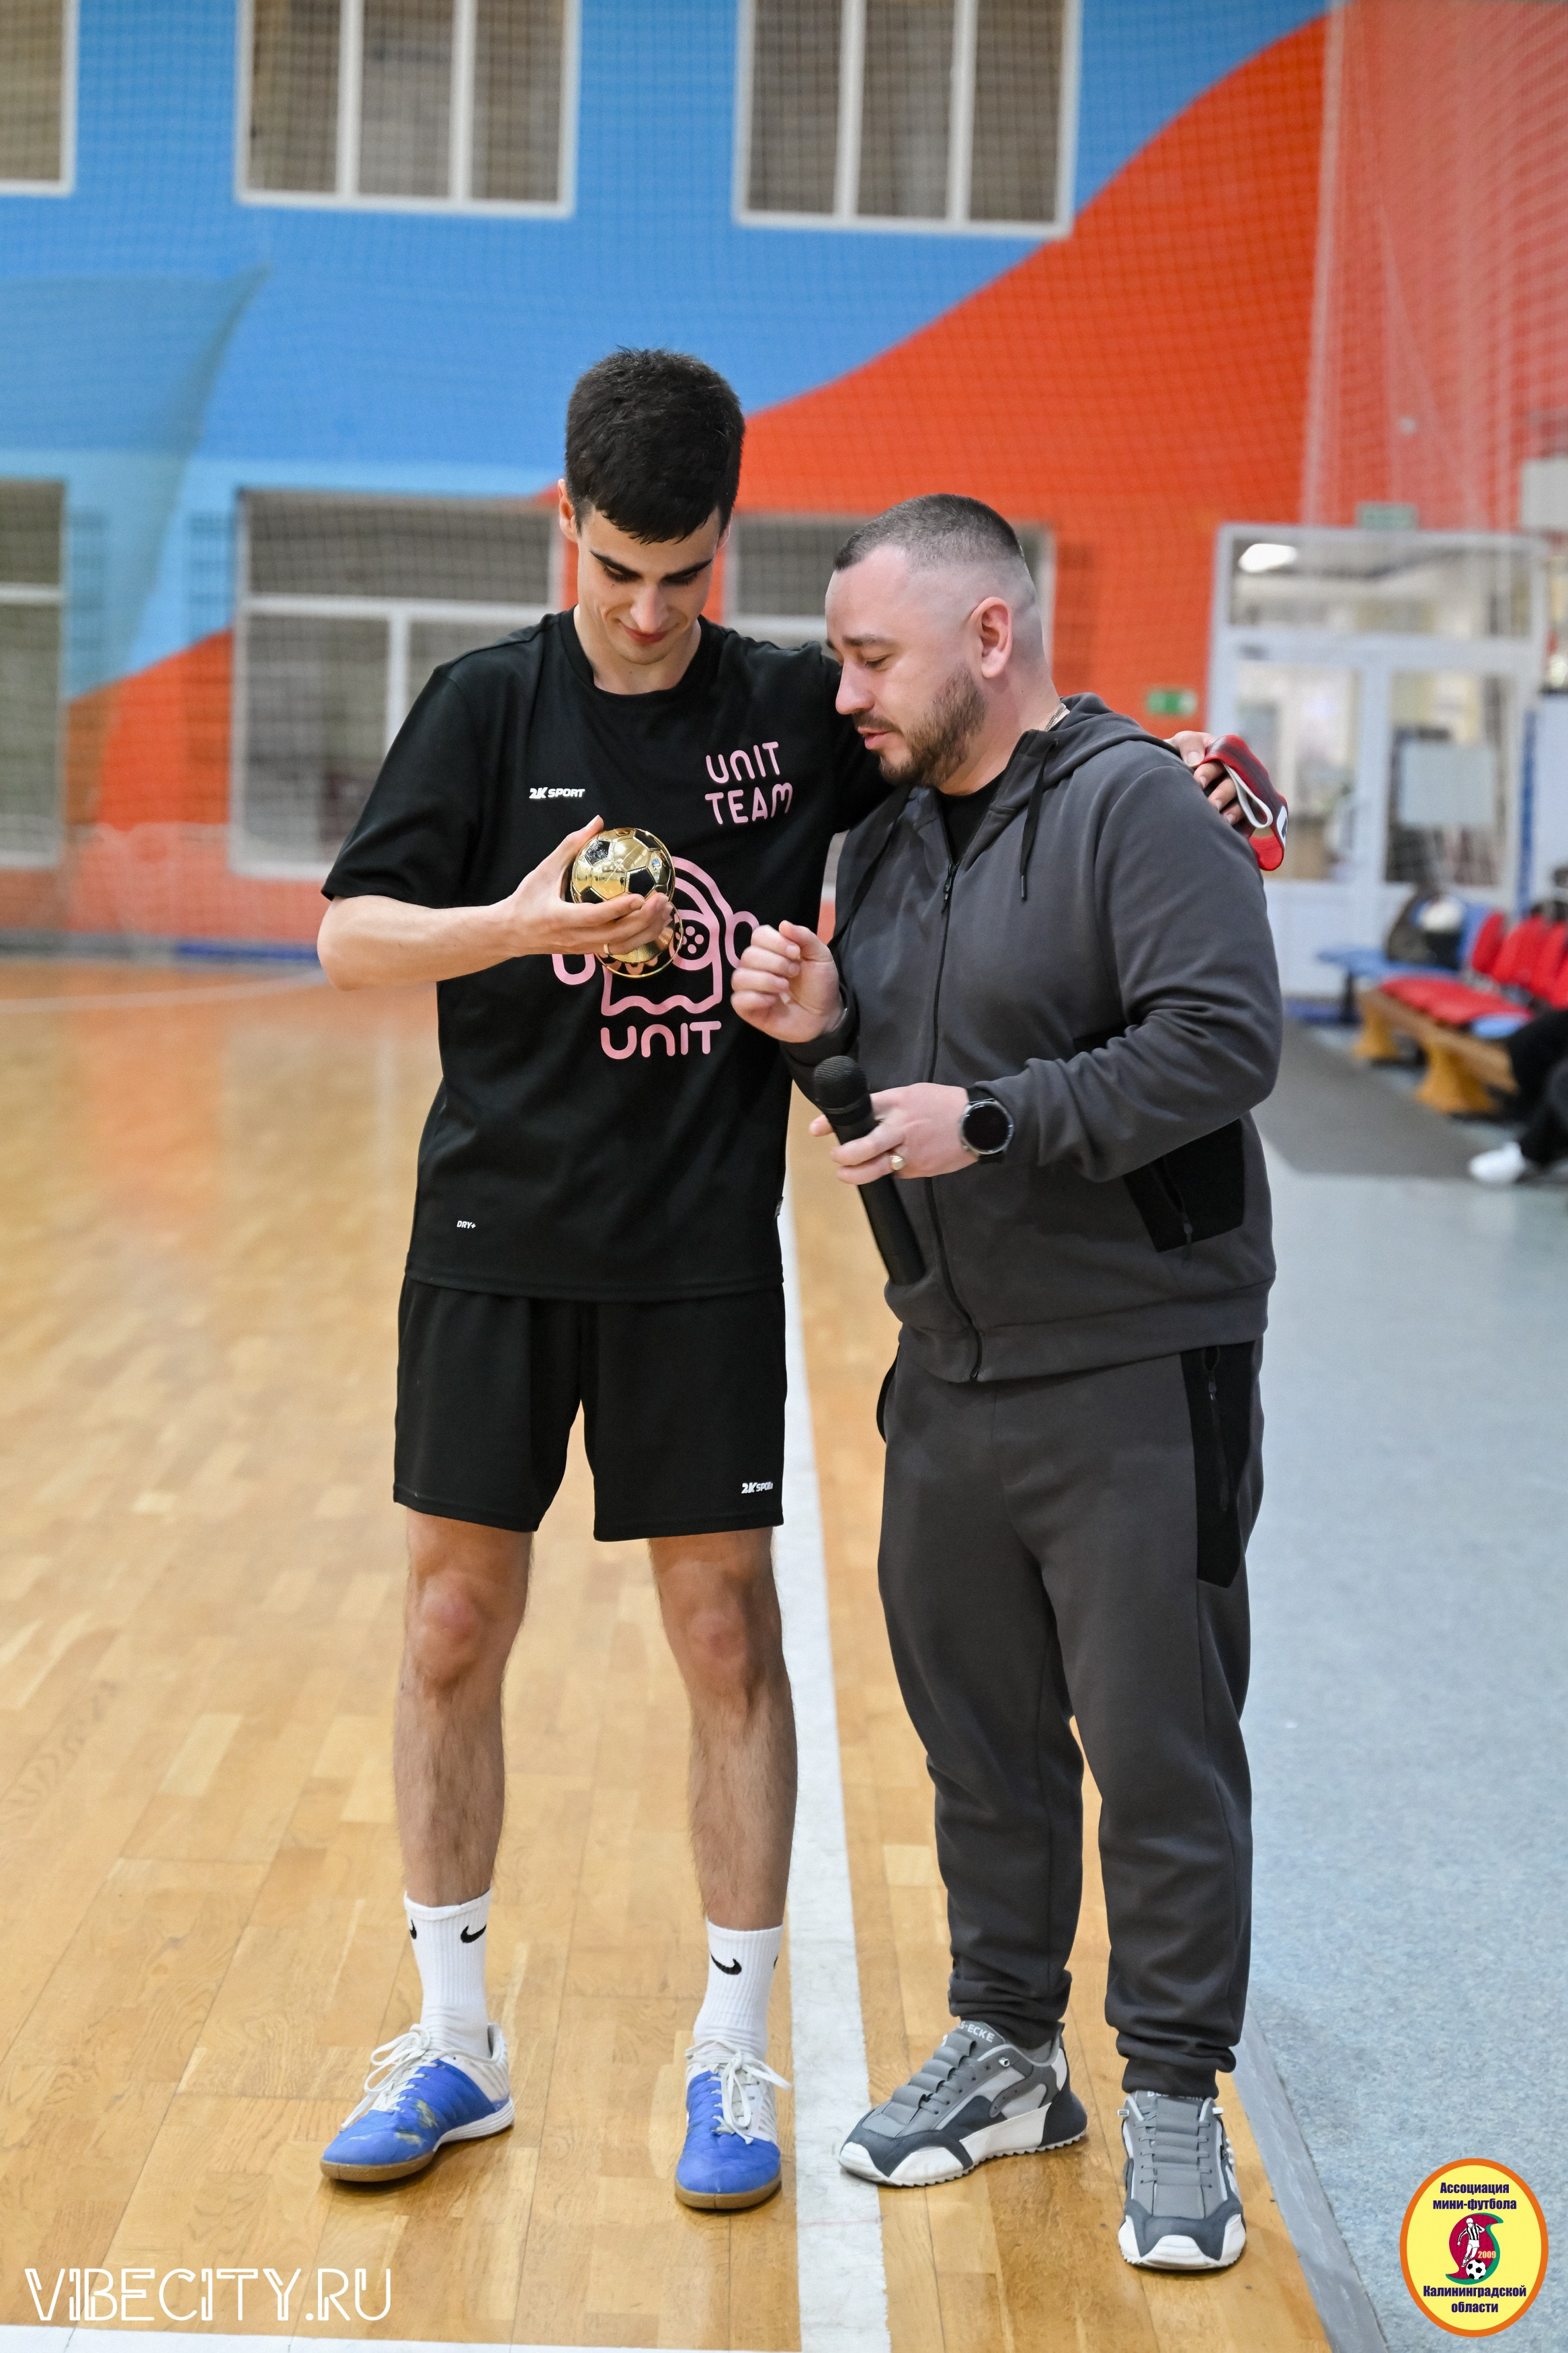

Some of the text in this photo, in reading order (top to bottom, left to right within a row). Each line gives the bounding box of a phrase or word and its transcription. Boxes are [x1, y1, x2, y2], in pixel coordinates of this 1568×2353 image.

[706, 742, 780, 784] UNIT
[529, 787, 585, 799] 2K SPORT
[704, 783, 793, 825] TEAM
[600, 1021, 722, 1060] UNIT
